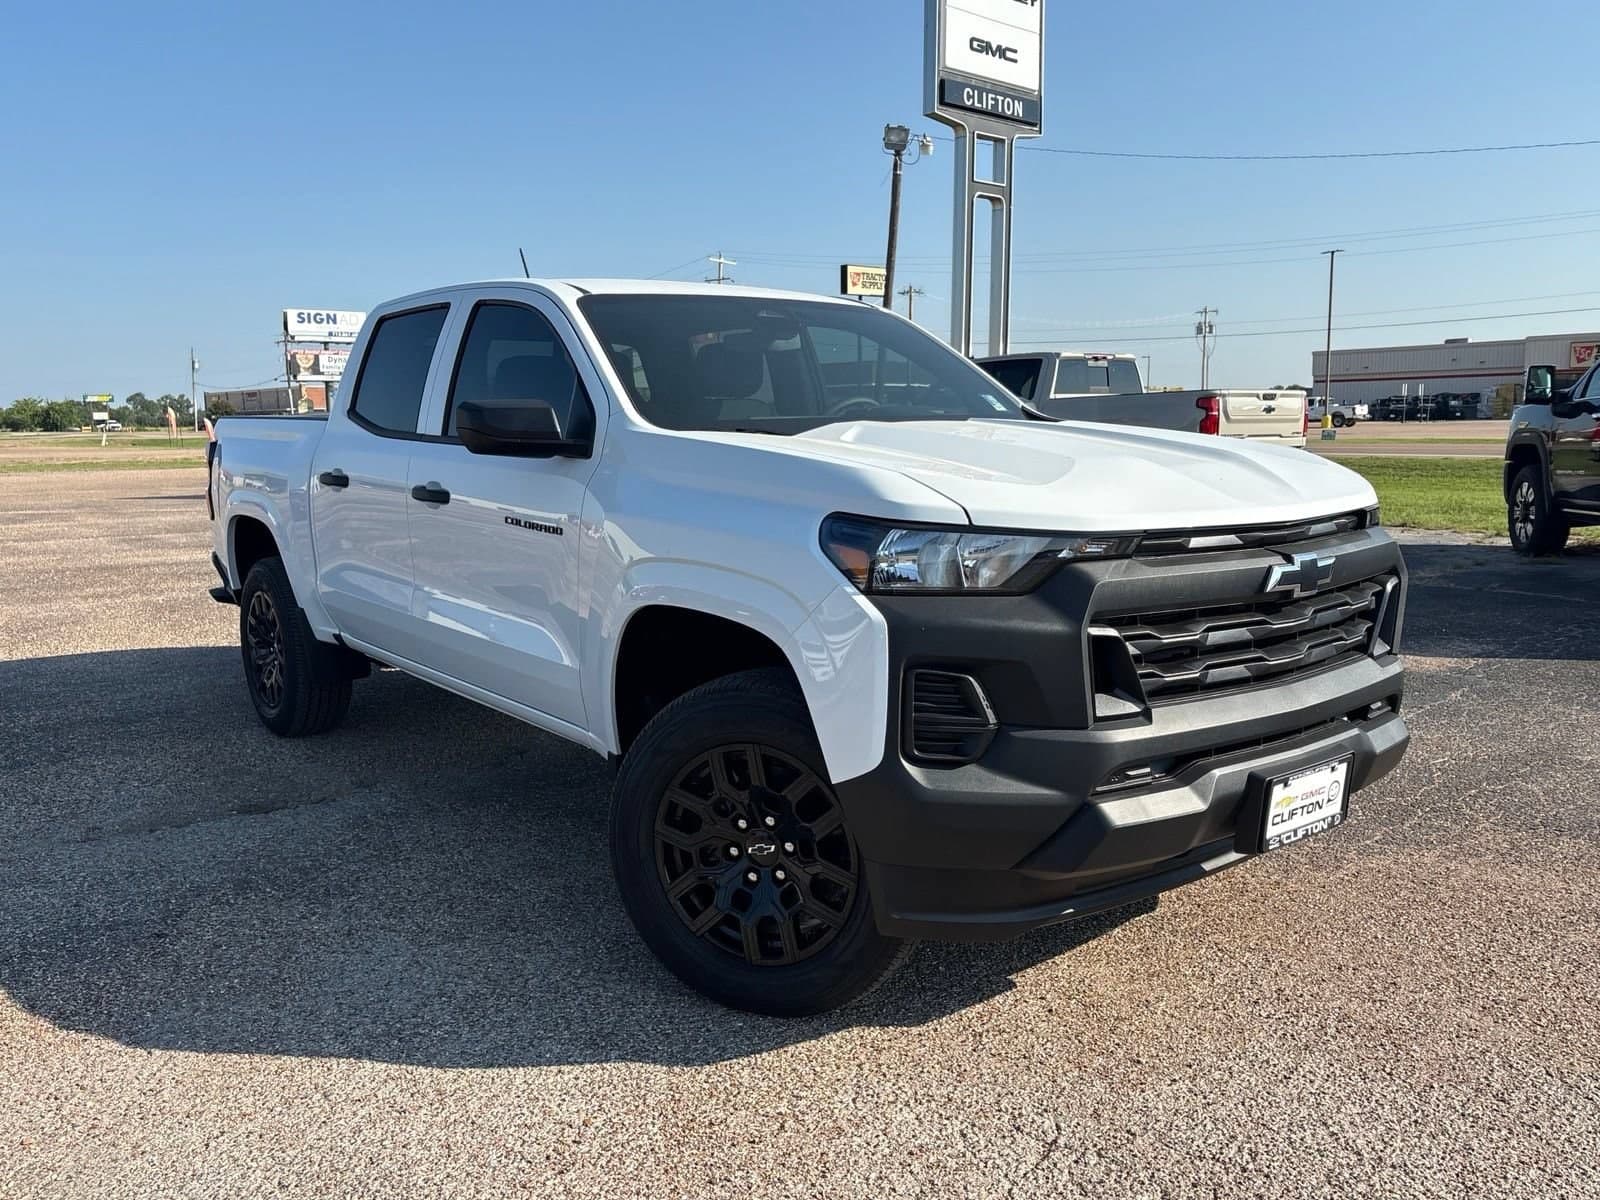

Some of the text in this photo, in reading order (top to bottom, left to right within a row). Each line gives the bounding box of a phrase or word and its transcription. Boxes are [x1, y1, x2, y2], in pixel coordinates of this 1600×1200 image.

[969, 36, 1018, 64] GMC
[963, 87, 1023, 118] CLIFTON
[861, 272, 886, 282] TRACTO
[861, 281, 883, 290] SUPPLY
[296, 311, 337, 325] SIGN
[327, 356, 347, 364] Dyna
[504, 515, 564, 536] COLORADO
[1301, 785, 1327, 802] GMC
[1271, 798, 1325, 827] CLIFTON
[1282, 818, 1328, 844] CLIFTON
